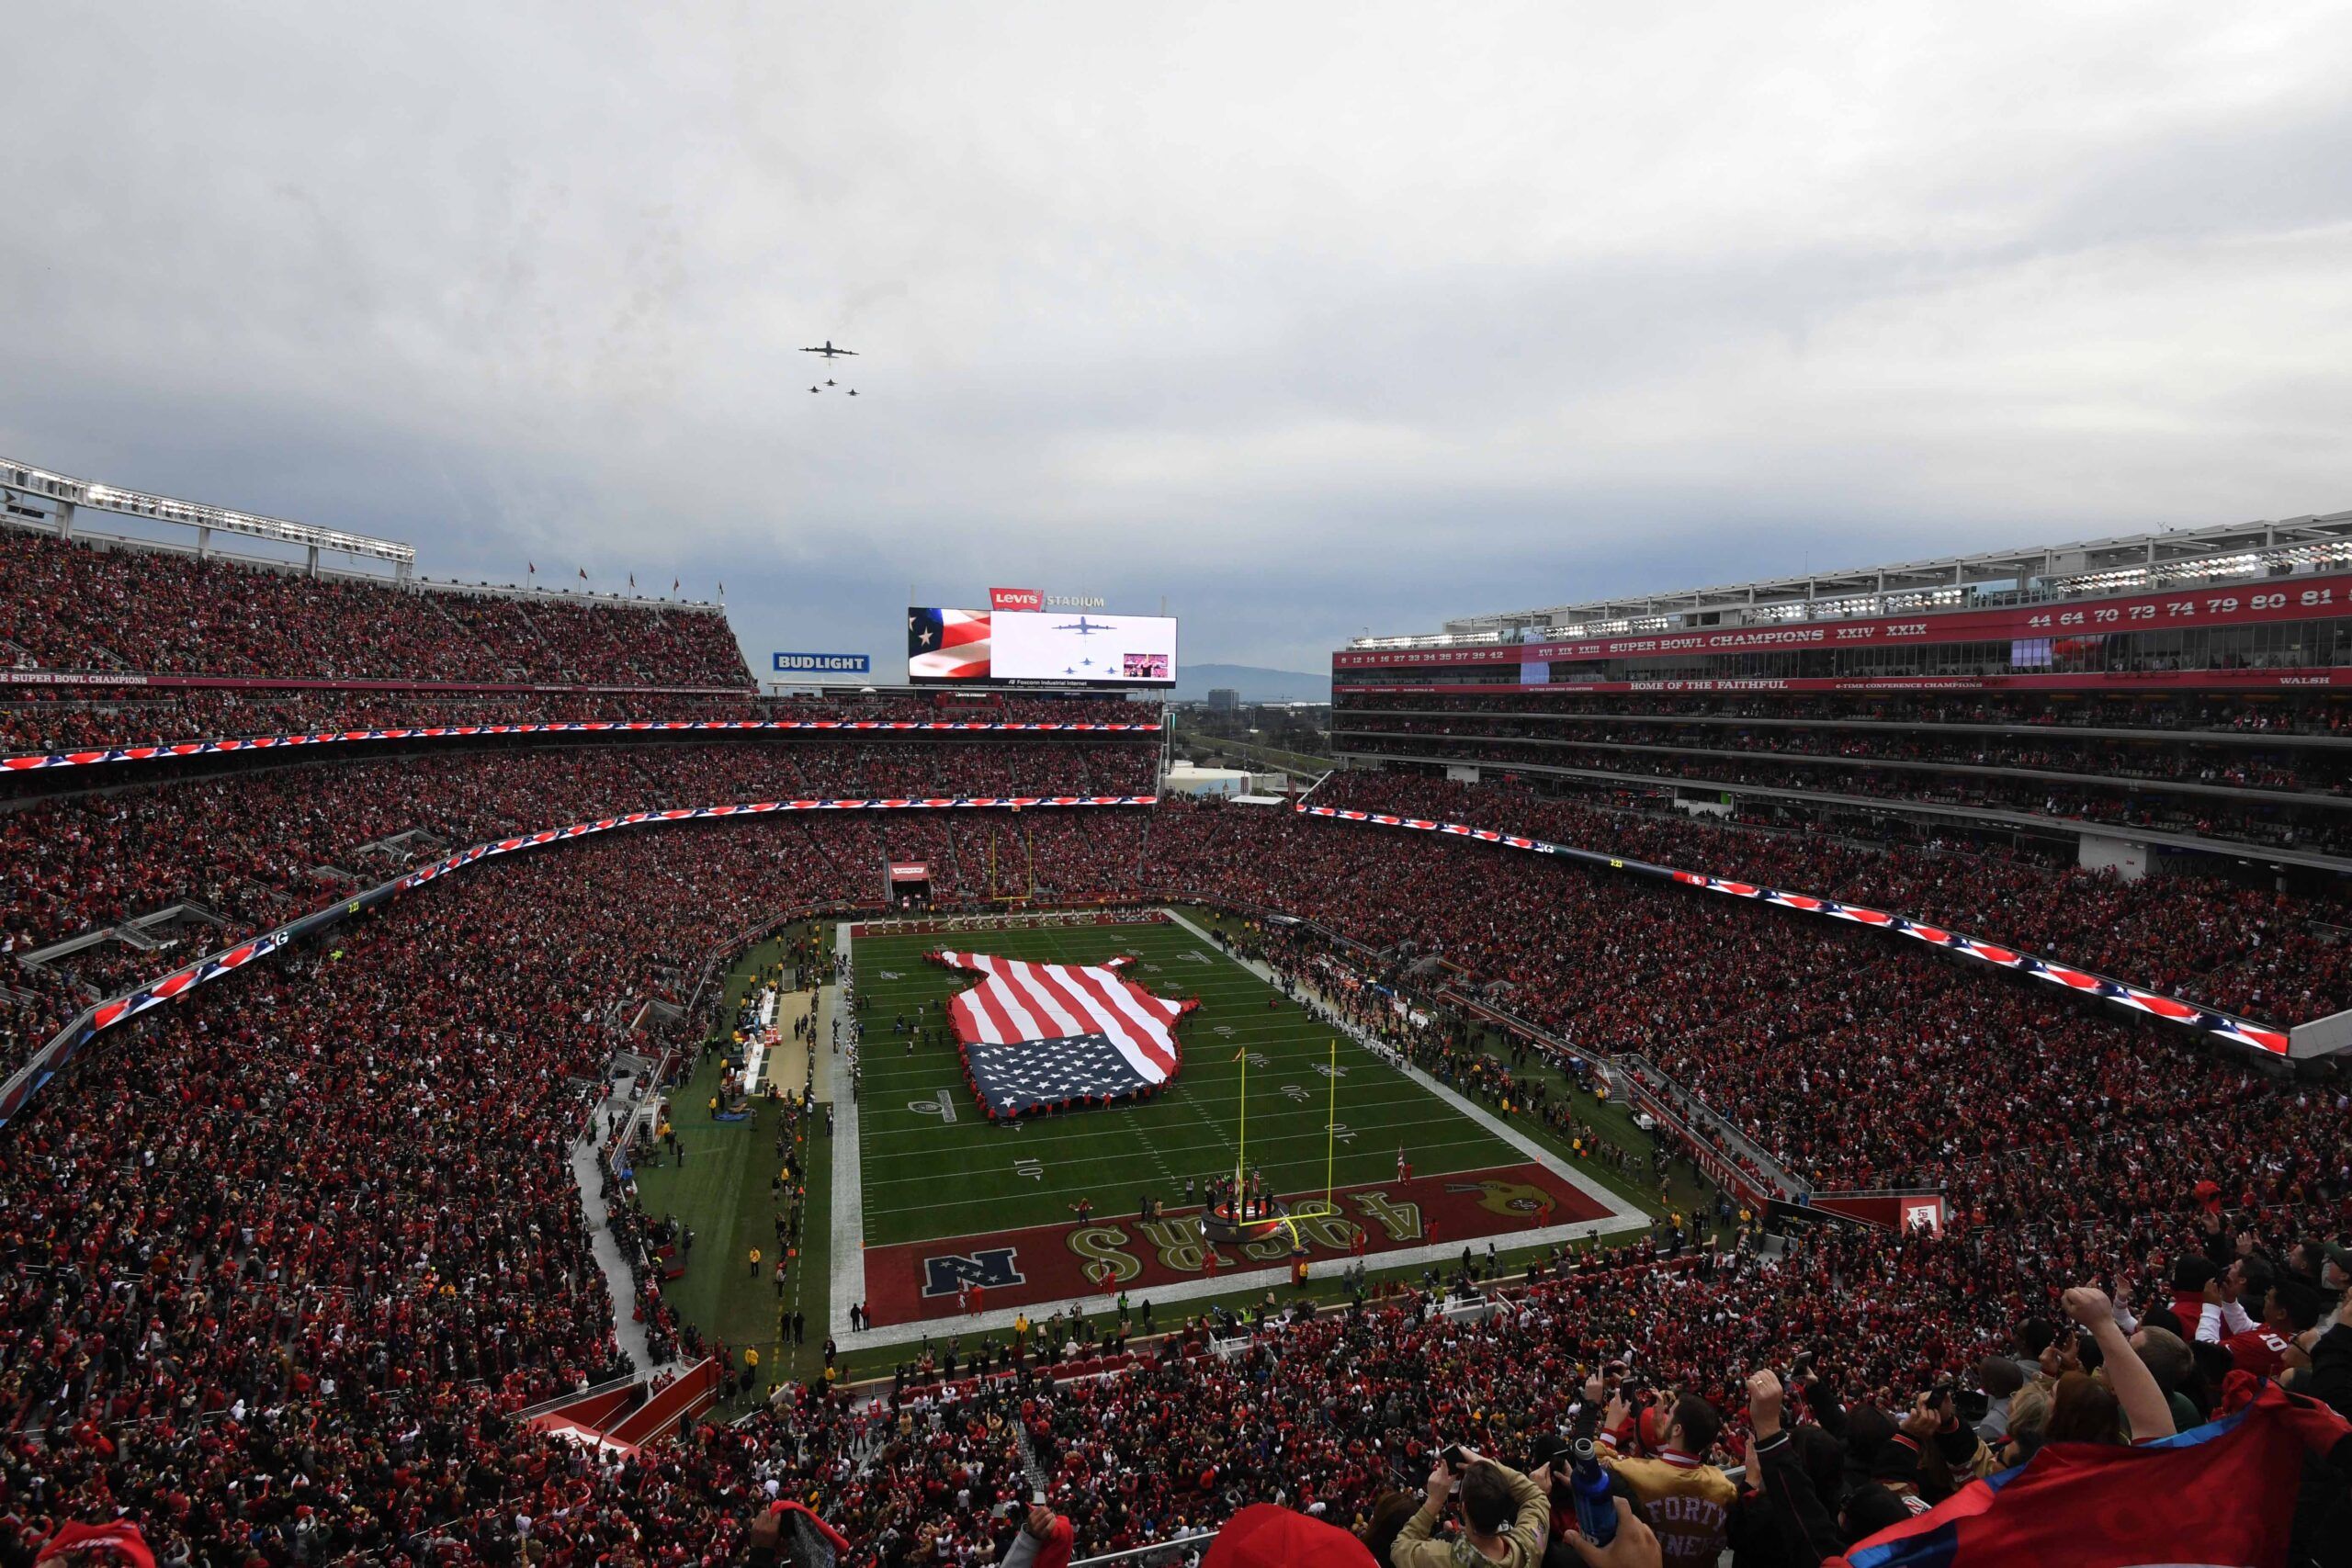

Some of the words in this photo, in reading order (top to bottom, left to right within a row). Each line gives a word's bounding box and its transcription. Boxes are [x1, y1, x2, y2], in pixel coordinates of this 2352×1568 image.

[1046, 595, 1104, 607] STADIUM
[2029, 615, 2052, 627] 44
[2060, 611, 2085, 626] 64
[2094, 608, 2119, 623] 70
[2129, 604, 2156, 620] 73
[2167, 602, 2195, 617] 74
[2207, 597, 2239, 614] 79
[2250, 592, 2287, 610] 80
[2301, 588, 2333, 606] 81
[1538, 648, 1553, 657] XVI
[1557, 647, 1573, 656] XIX
[1578, 645, 1600, 655] XXIII
[1609, 640, 1657, 653] SUPER
[1660, 637, 1706, 650] BOWL
[1710, 628, 1825, 648] CHAMPIONS
[1837, 626, 1875, 640] XXIV
[1886, 624, 1928, 637] XXIX
[778, 656, 815, 669] BUD
[815, 657, 865, 670] LIGHT
[1455, 652, 1468, 660] 37
[11, 673, 52, 683] SUPER
[54, 674, 86, 683] BOWL
[88, 675, 148, 684] CHAMPIONS
[1687, 681, 1713, 689] THE
[1717, 680, 1788, 690] FAITHFUL
[1610, 859, 1623, 868] 3:23
[1280, 1085, 1311, 1099] 20
[1324, 1123, 1358, 1138] 10
[1013, 1157, 1044, 1177] 10
[2257, 1333, 2288, 1352] 10
[1645, 1496, 1727, 1532] FORTY
[714, 1547, 723, 1556] 97
